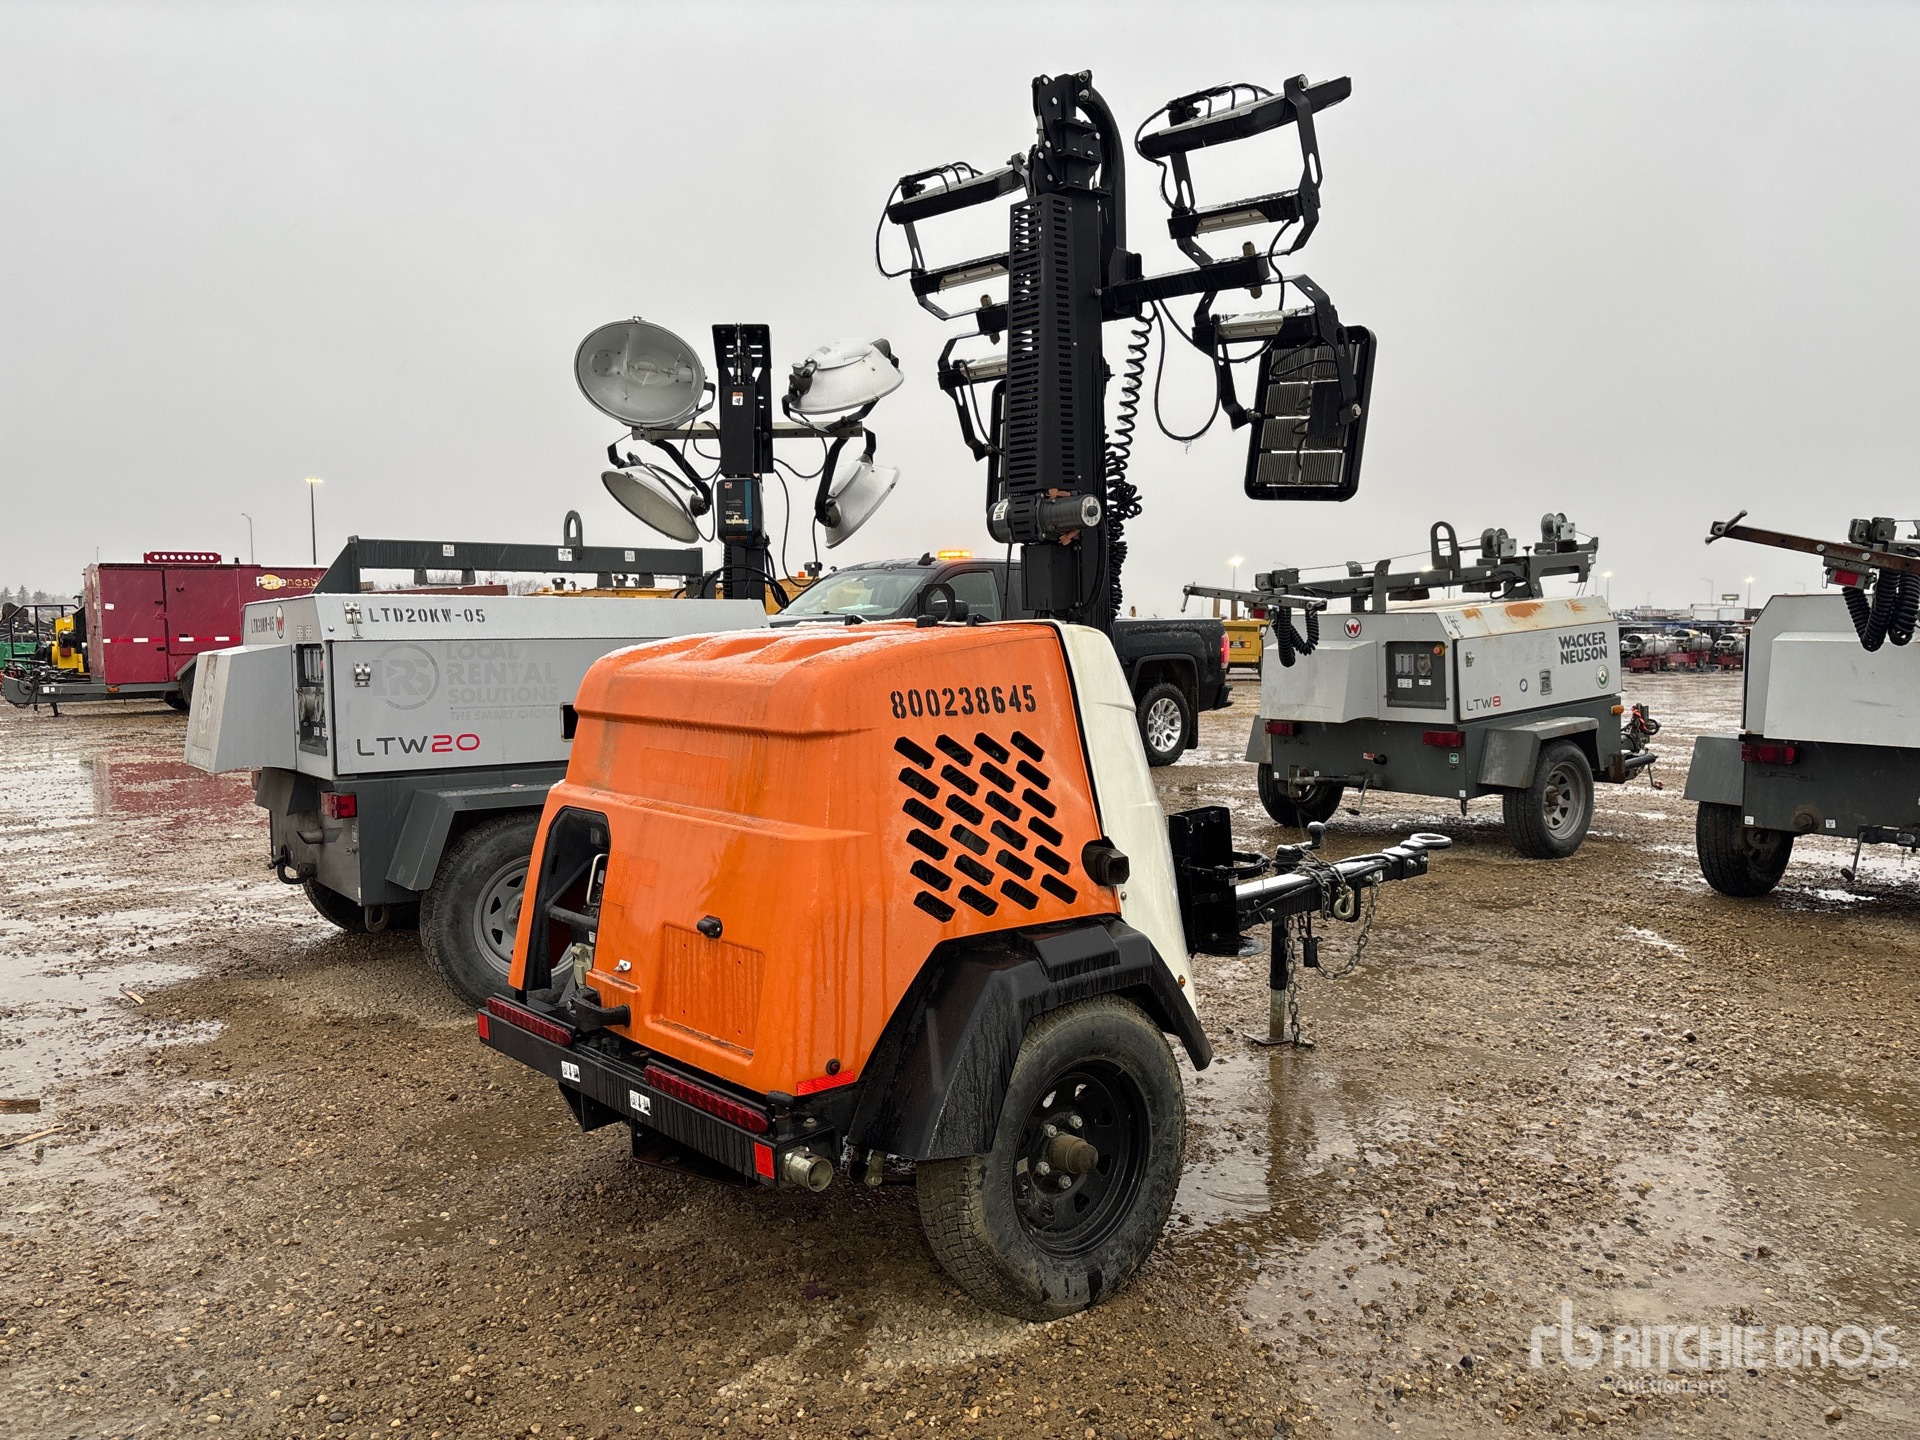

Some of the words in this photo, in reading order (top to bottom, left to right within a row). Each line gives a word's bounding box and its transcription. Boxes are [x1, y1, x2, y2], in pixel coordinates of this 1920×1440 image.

[368, 607, 486, 623] LTD20KW-05
[1558, 631, 1607, 650] WACKER
[446, 642, 520, 661] LOCAL
[1560, 645, 1608, 665] NEUSON
[446, 662, 558, 686] RENTAL
[448, 686, 559, 704] SOLUTIONS
[890, 684, 1037, 720] 800238645
[1466, 695, 1501, 711] LTW8
[449, 711, 472, 721] THE
[475, 710, 515, 720] SMART
[356, 733, 480, 757] LTW20
